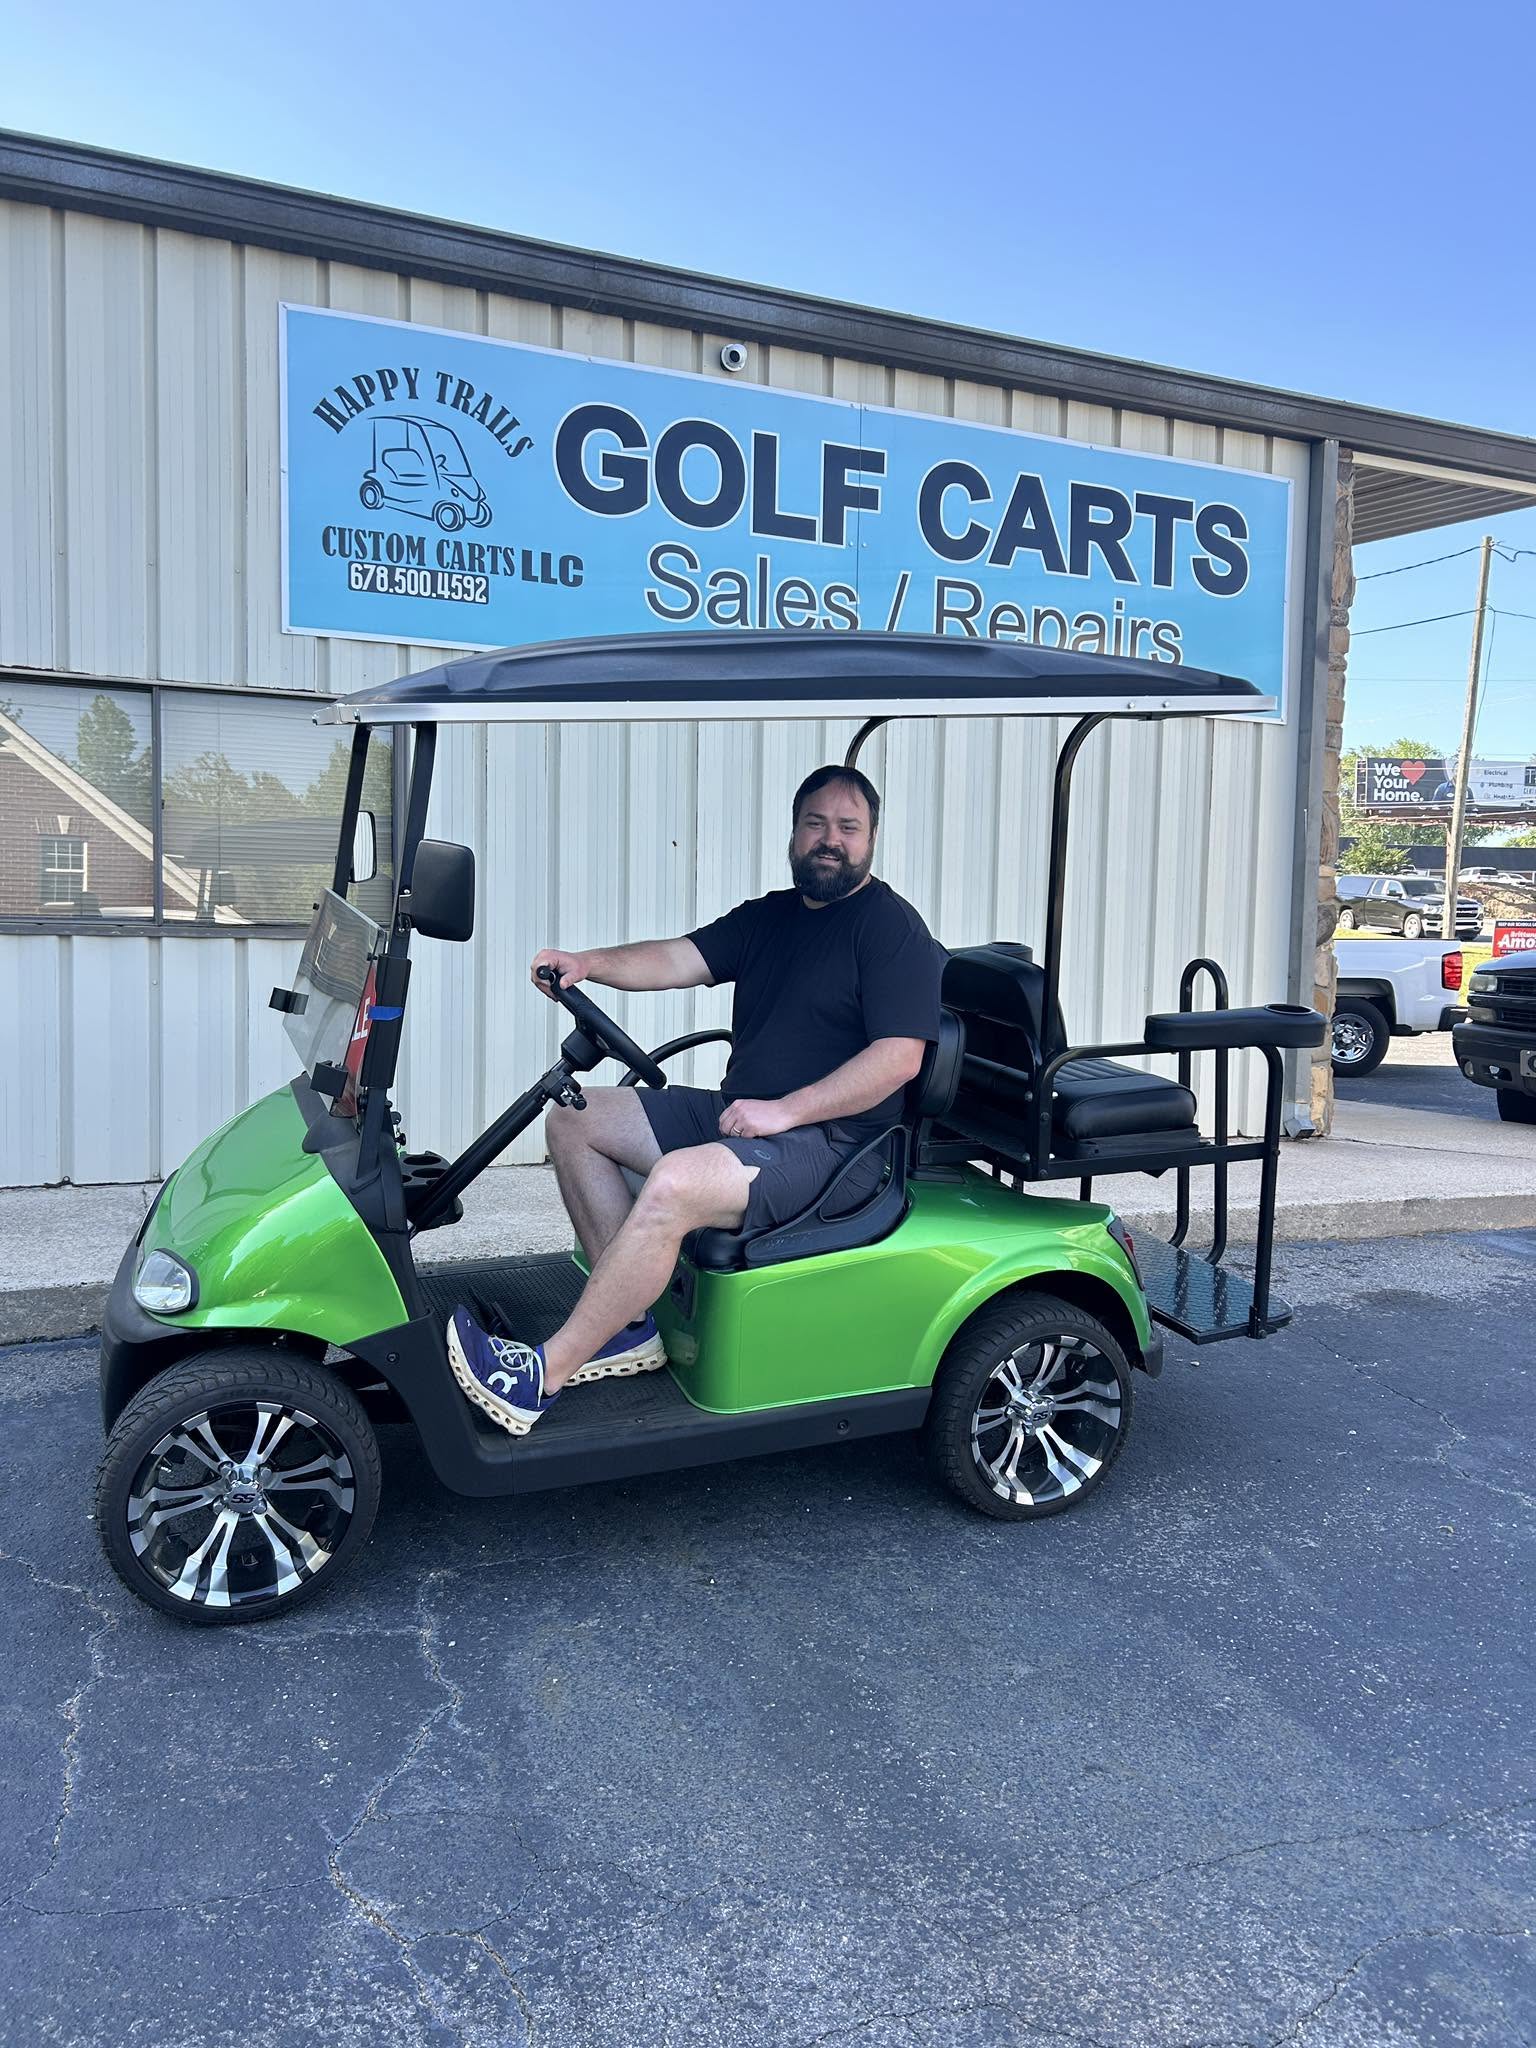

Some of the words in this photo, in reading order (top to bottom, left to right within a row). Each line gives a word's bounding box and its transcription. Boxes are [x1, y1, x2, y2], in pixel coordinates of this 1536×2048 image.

[313, 367, 420, 435] HAPPY
[435, 371, 535, 459] TRAILS
[554, 403, 886, 547] GOLF
[918, 460, 1249, 597] CARTS
[321, 525, 426, 567] CUSTOM
[436, 538, 515, 577] CARTS
[521, 549, 584, 588] LLC
[350, 562, 487, 603] 678.500.4592
[646, 543, 859, 630] Sales
[936, 577, 1183, 665] Repairs
[1373, 775, 1410, 789] Your
[1374, 762, 1401, 776] We
[1373, 788, 1425, 803] Home.
[1499, 933, 1536, 949] Amo
[230, 1493, 256, 1504] SS
